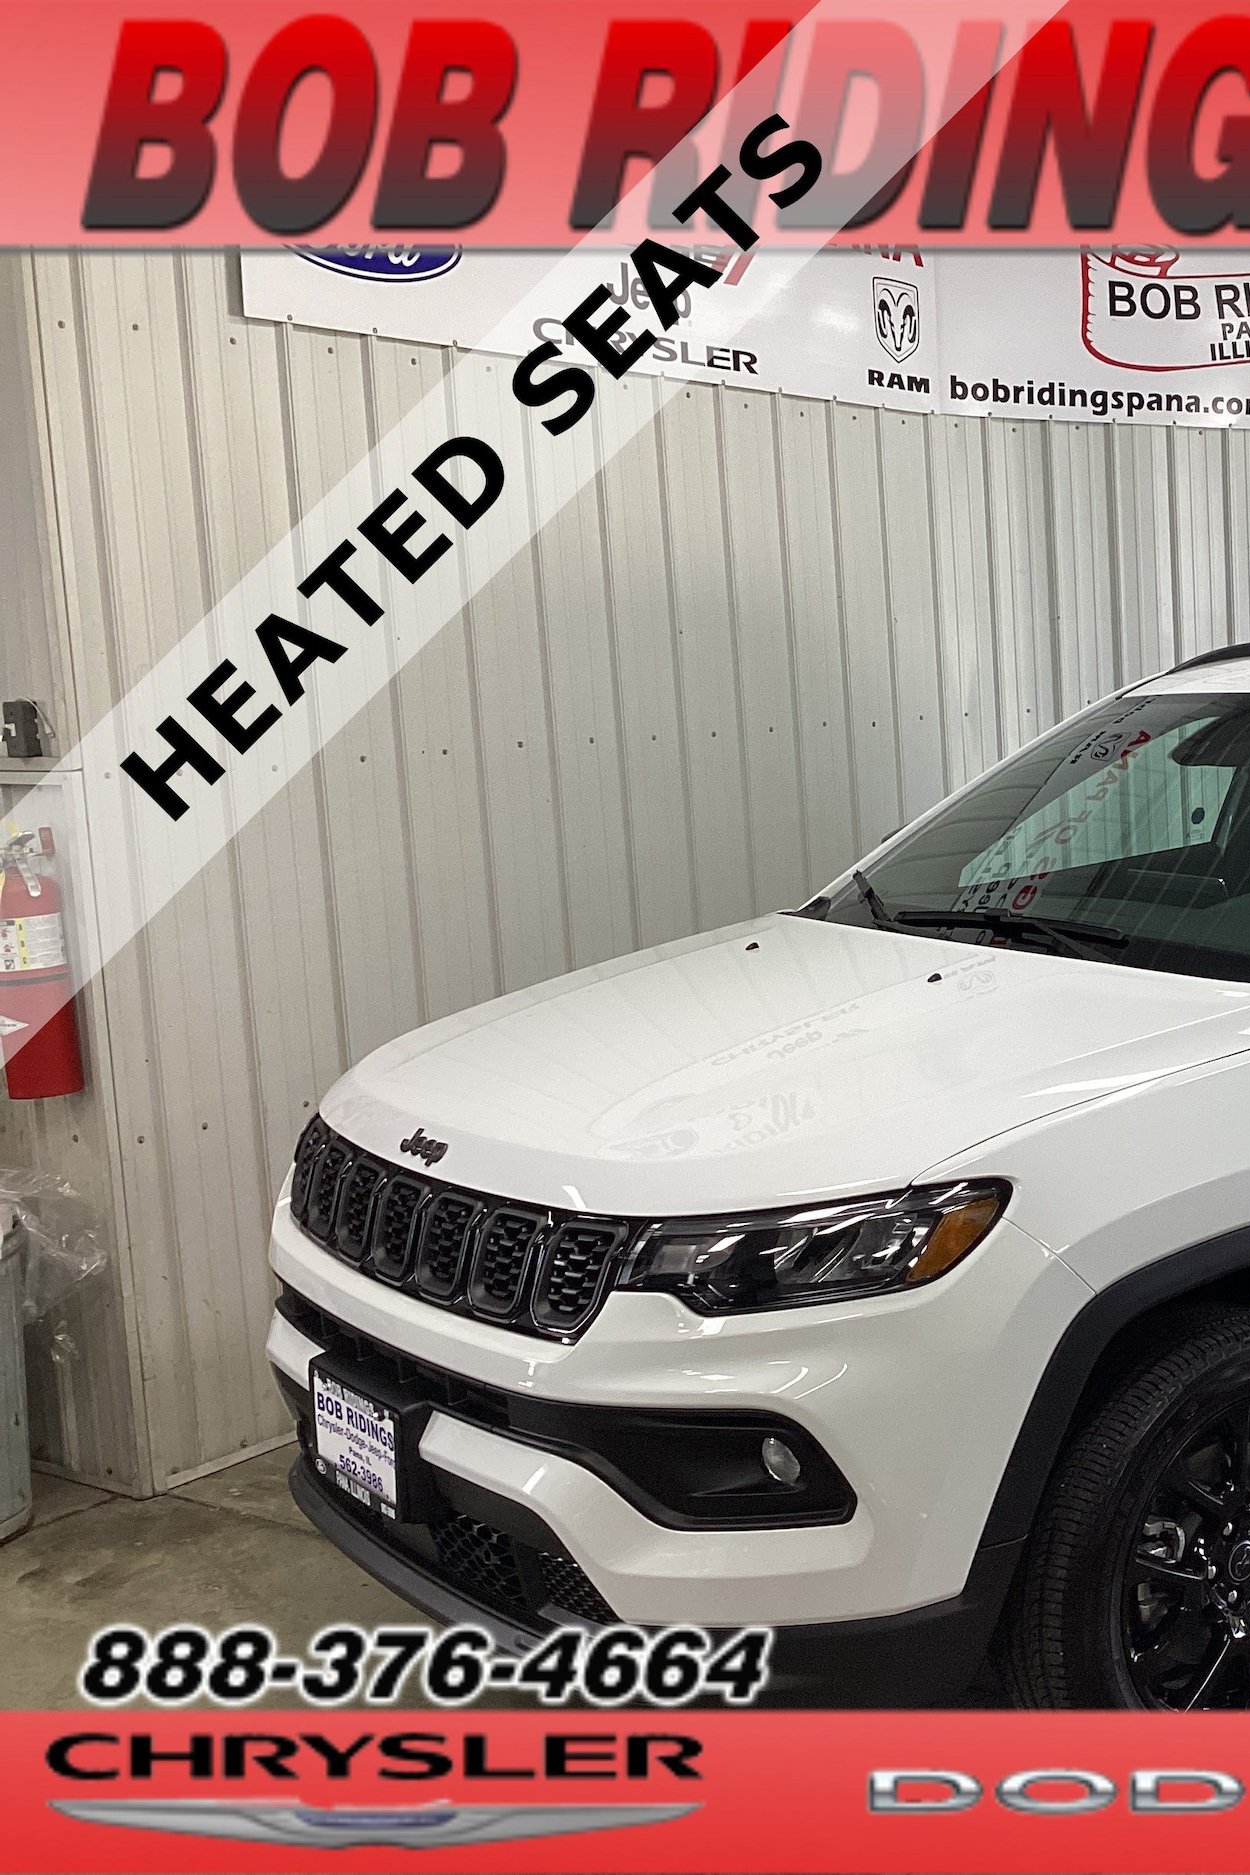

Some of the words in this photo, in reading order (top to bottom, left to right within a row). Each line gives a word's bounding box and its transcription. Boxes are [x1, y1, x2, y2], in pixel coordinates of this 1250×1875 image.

[606, 261, 692, 326] Jep
[1108, 279, 1201, 321] BOB
[867, 368, 931, 394] RAM
[400, 1128, 449, 1168] Jeep
[316, 1391, 343, 1420] BOB
[346, 1406, 396, 1452] RIDINGS
[339, 1454, 384, 1493] 562-3986
